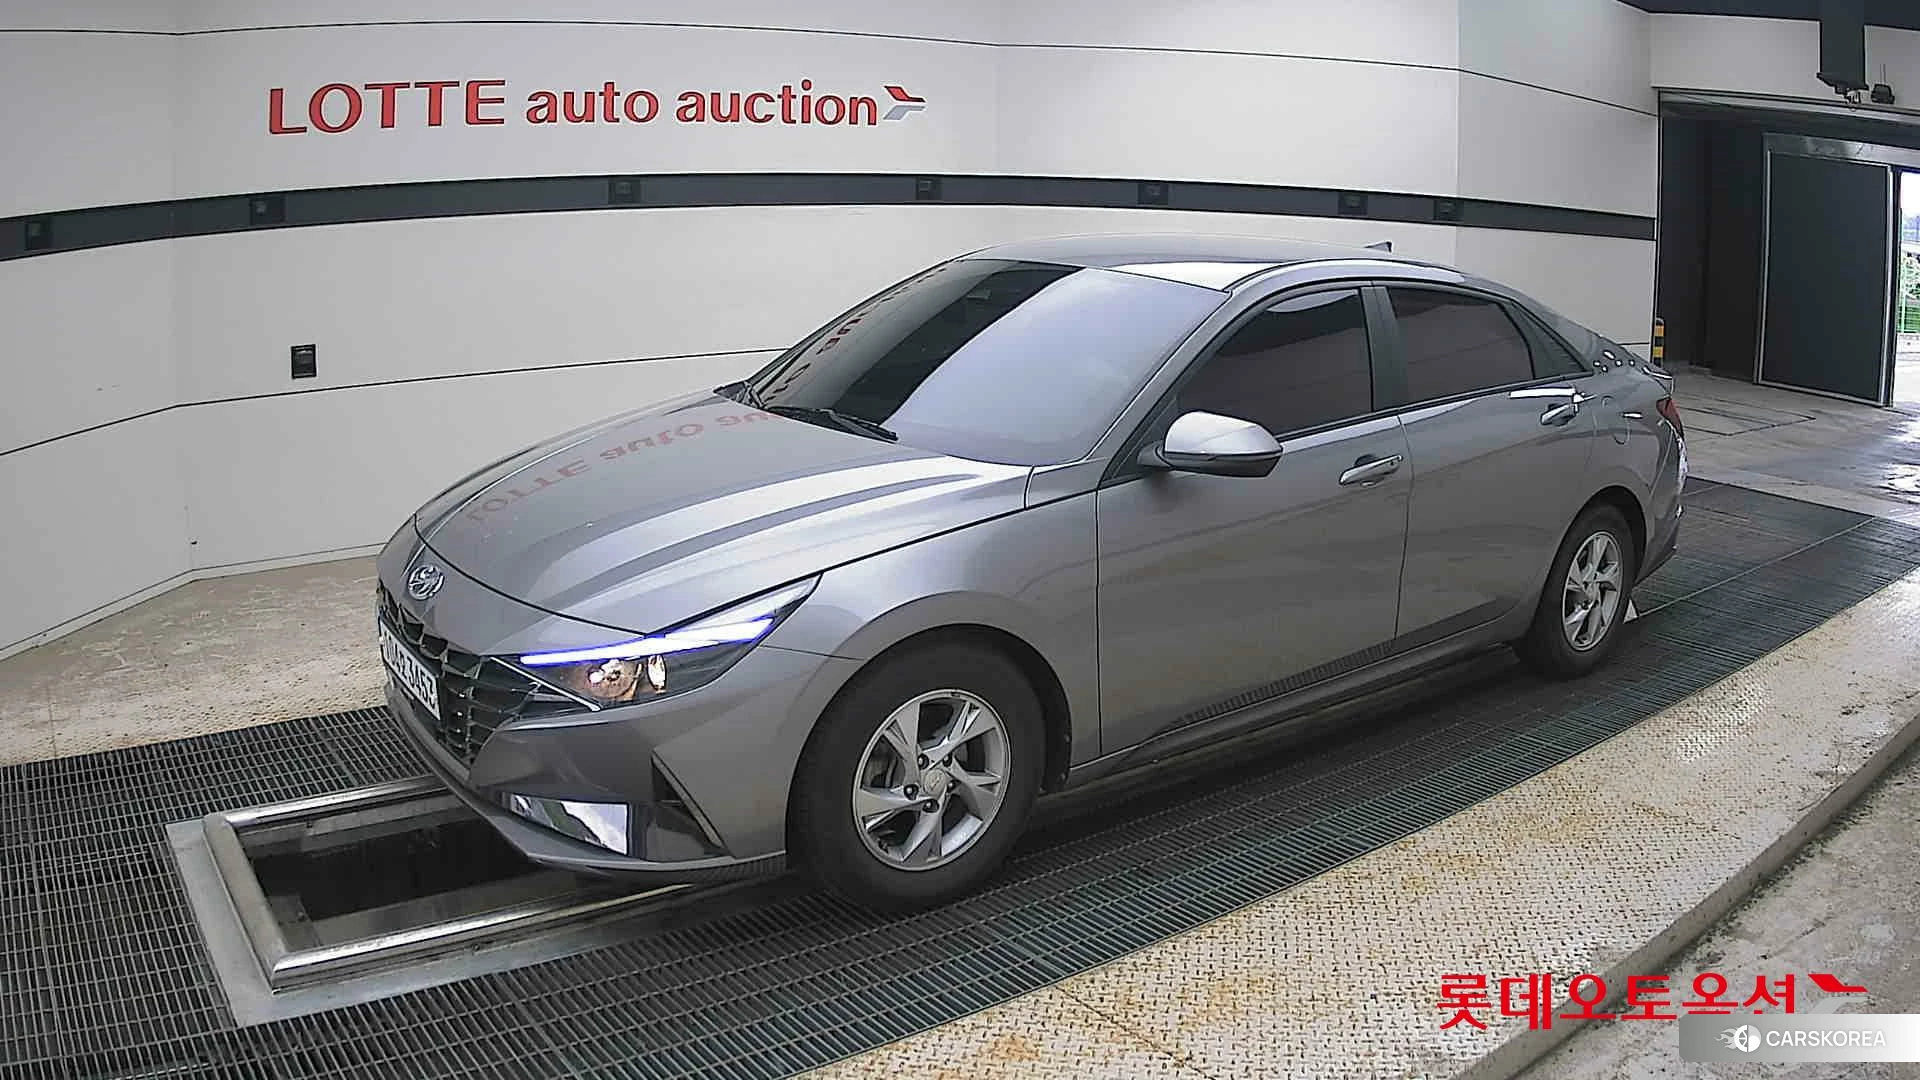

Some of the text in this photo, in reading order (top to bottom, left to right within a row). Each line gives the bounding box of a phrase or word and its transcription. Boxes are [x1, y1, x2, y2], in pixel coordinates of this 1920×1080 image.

[268, 79, 878, 136] LOTTE auto auction
